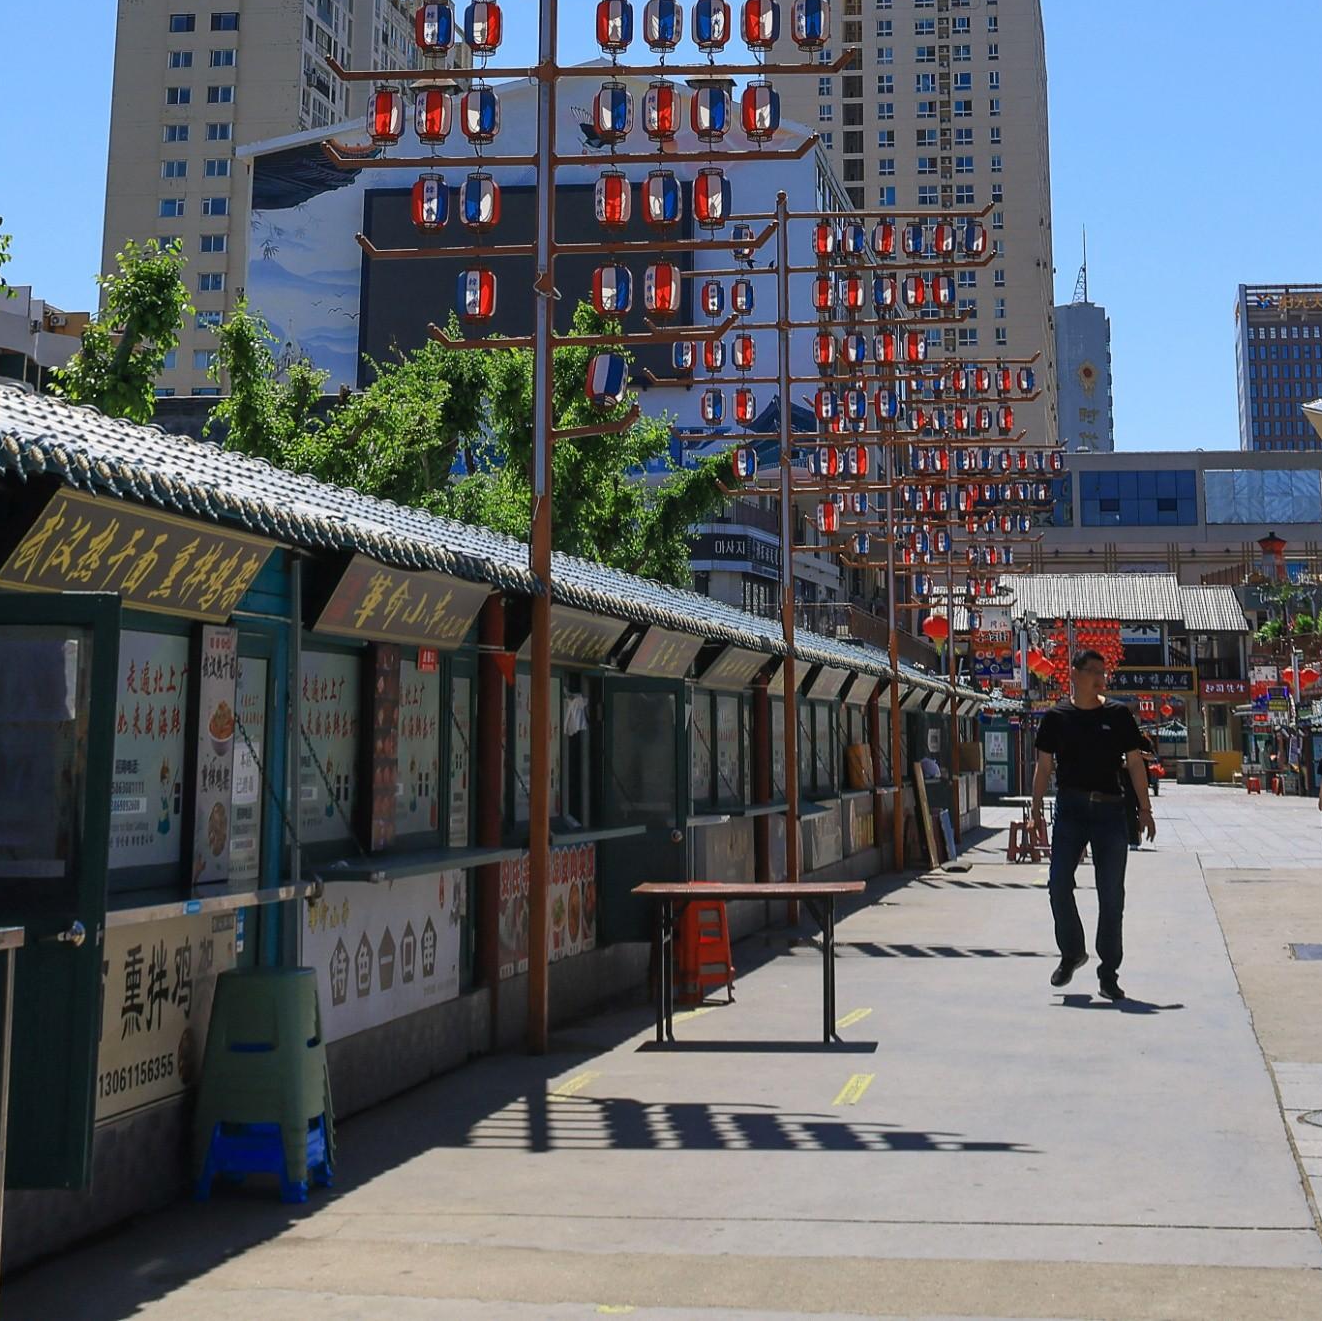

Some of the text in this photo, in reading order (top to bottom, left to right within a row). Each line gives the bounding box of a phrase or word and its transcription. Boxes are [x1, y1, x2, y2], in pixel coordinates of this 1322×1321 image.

[126, 658, 192, 701] 走遍北上广
[330, 929, 437, 1000] 特色一口串
[99, 1053, 174, 1099] 13061156355
